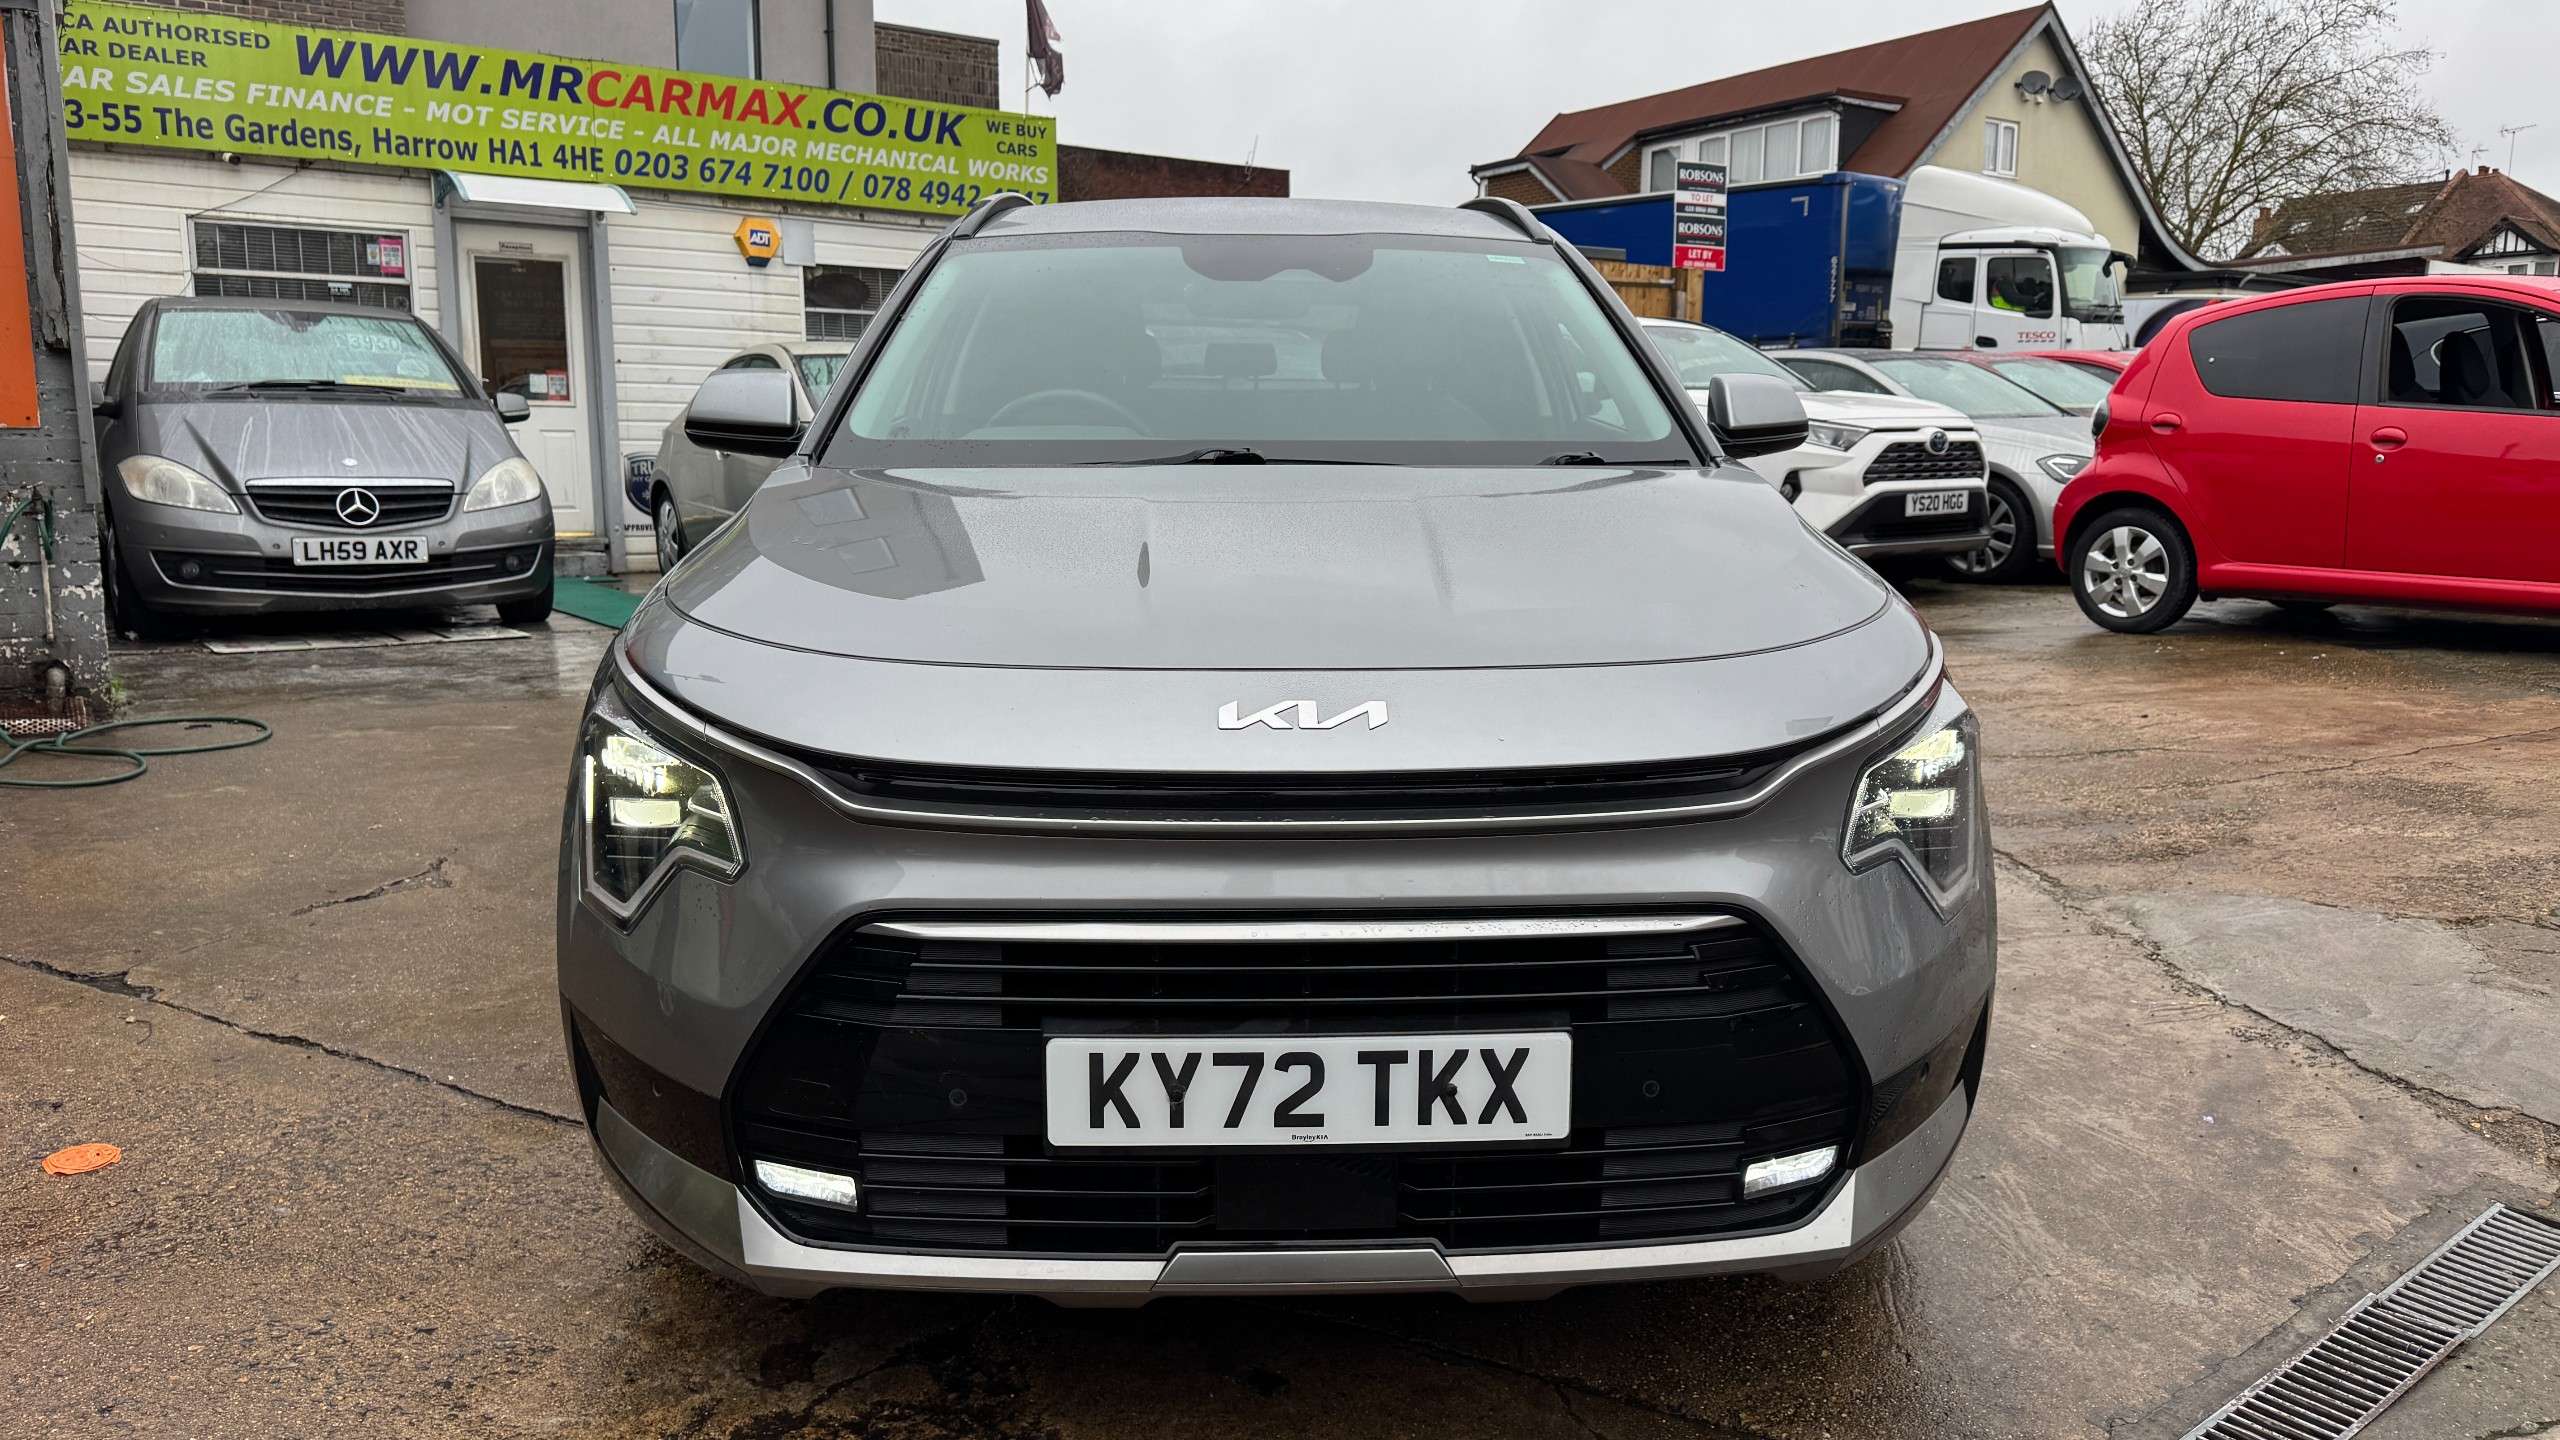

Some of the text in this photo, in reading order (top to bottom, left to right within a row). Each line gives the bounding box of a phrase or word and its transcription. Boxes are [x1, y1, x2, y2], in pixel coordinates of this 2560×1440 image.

[103, 16, 270, 49] AUTHORISED
[61, 37, 208, 67] AR DEALER
[296, 34, 966, 147] WWW.MRCARMAX.CO.UK
[61, 65, 113, 91] AR
[125, 71, 235, 102] SALES
[246, 83, 393, 117] FINANCE
[426, 101, 493, 127] MOT
[501, 109, 626, 140] SERVICE
[652, 125, 701, 148] ALL
[710, 131, 797, 157] MAJOR
[805, 140, 959, 175] MECHANICAL
[968, 159, 1049, 184] WORKS
[986, 119, 1047, 139] WE BUY
[63, 99, 142, 134] 3-55
[153, 106, 213, 139] The
[225, 113, 361, 158] Gardens,
[373, 127, 478, 162] Harrow
[489, 138, 542, 168] HA1
[553, 144, 604, 173] 4HE
[614, 148, 689, 181] 0203
[699, 157, 752, 186] 674
[763, 163, 830, 194] 7100
[838, 171, 854, 201] /
[864, 173, 911, 201] 078
[919, 179, 980, 208] 4942
[996, 140, 1038, 158] CARS
[1679, 169, 1724, 184] ROBSONS
[1691, 193, 1714, 203] TO LET
[750, 232, 770, 246] ADT
[1678, 222, 1723, 237] ROBSONS
[1688, 248, 1713, 260] LET BY
[2017, 331, 2056, 339] TESCO
[1911, 493, 1963, 512] YS20 HGG
[303, 540, 418, 561] LH59 AXR
[1218, 700, 1389, 730] KIA
[1088, 1047, 1531, 1129] KY72 TKX
